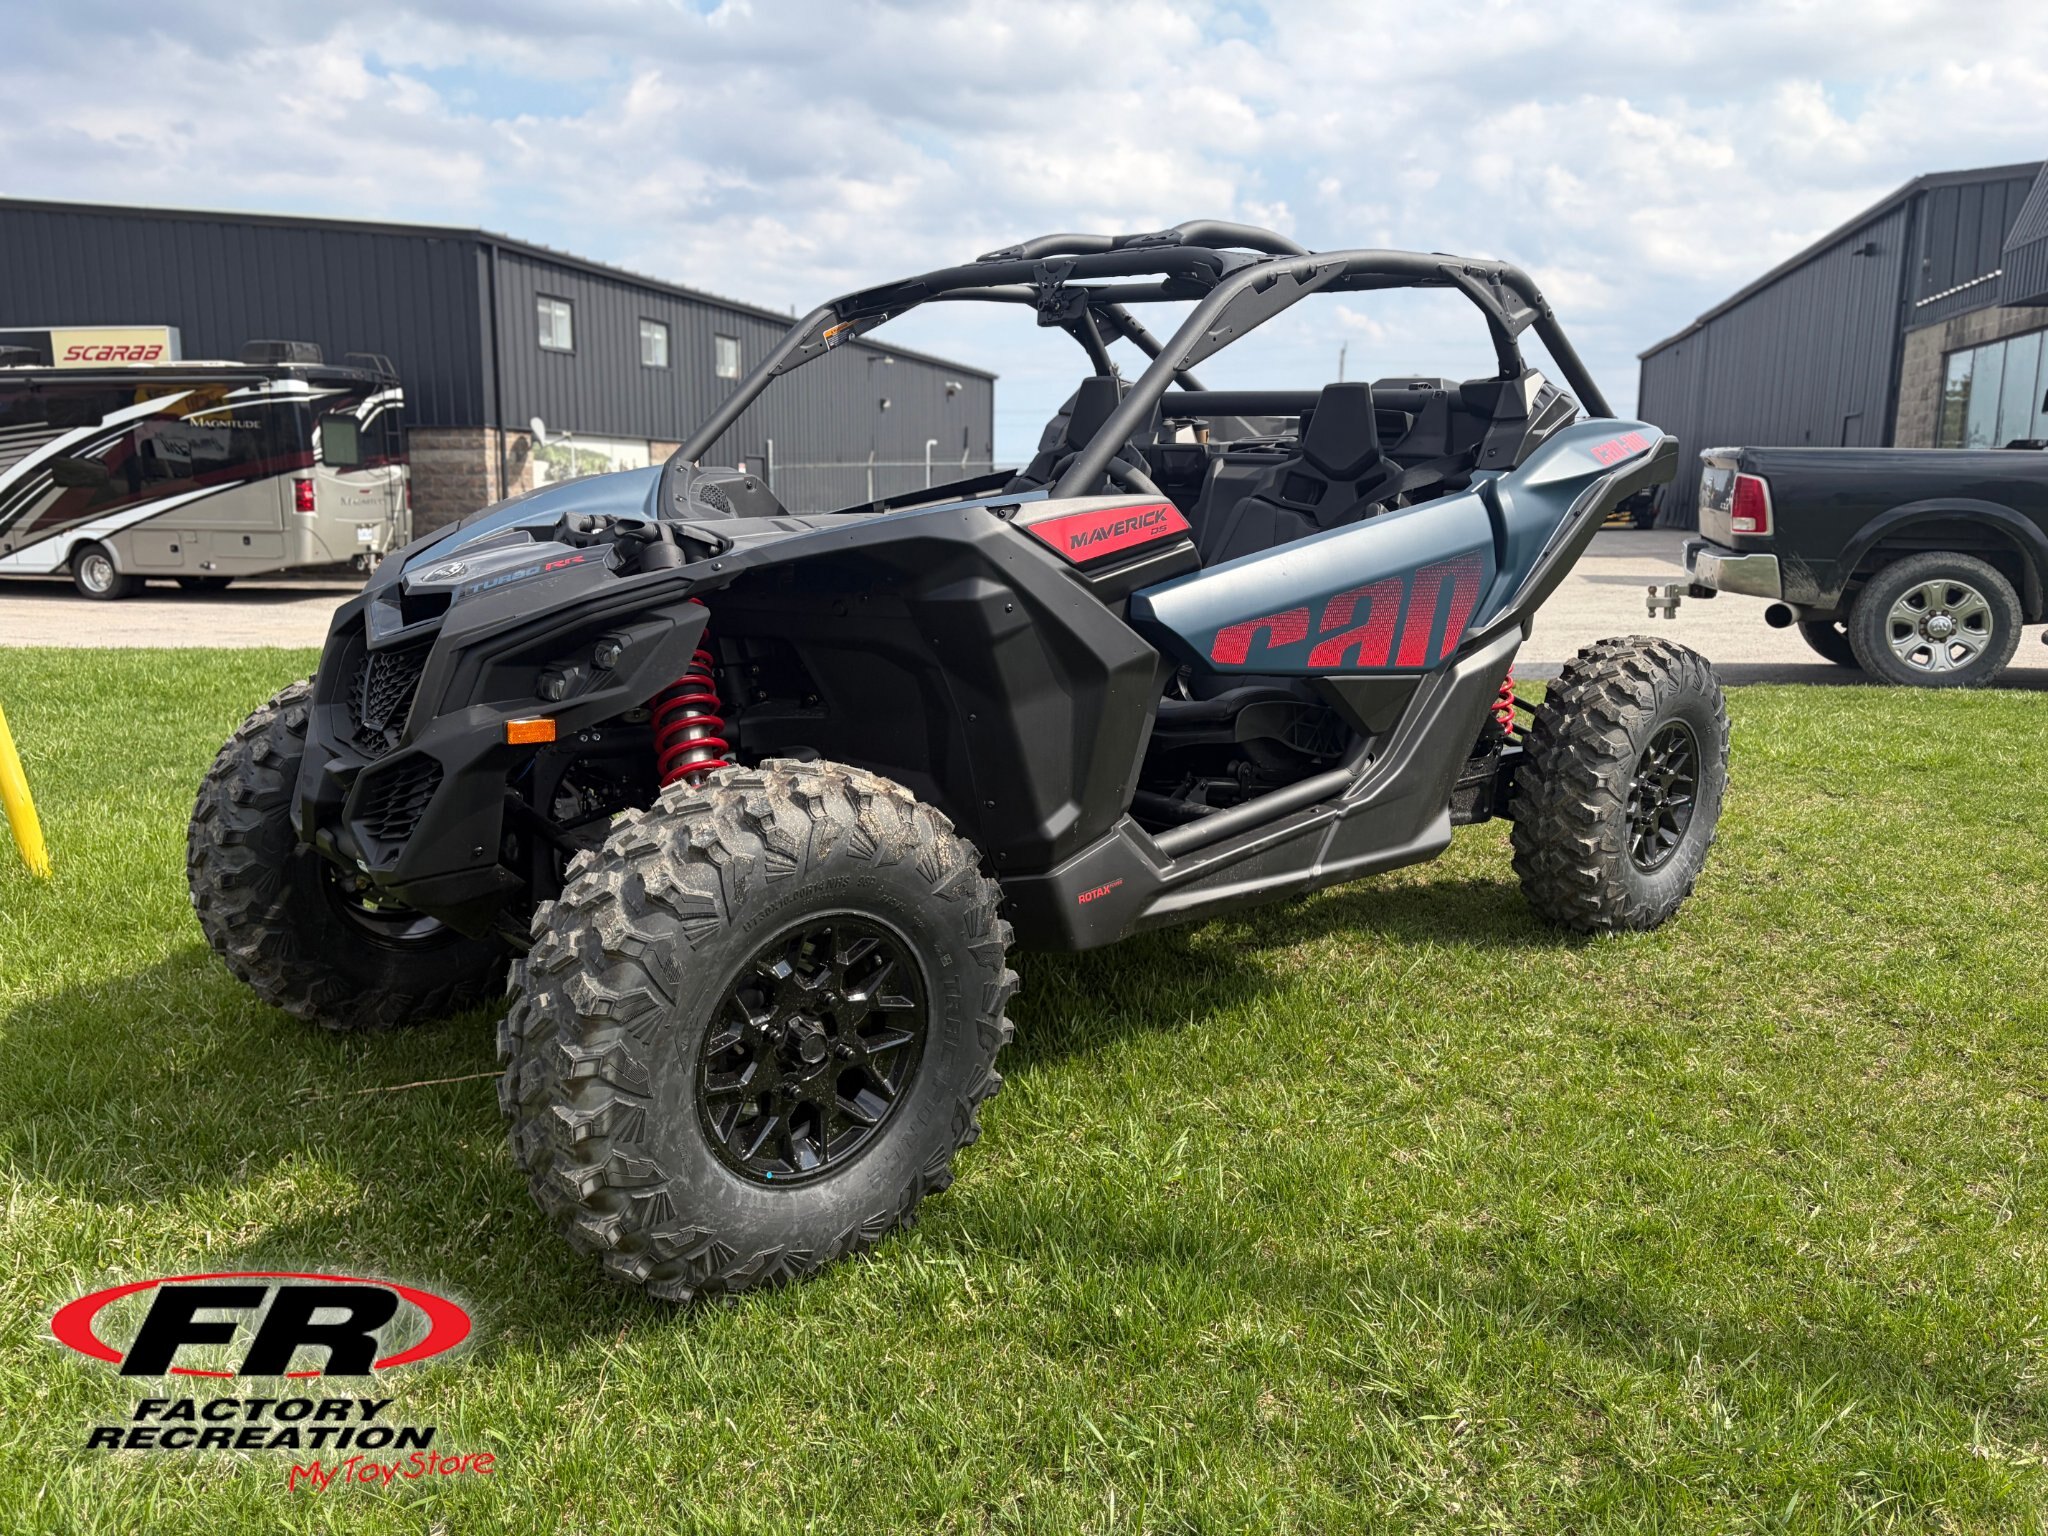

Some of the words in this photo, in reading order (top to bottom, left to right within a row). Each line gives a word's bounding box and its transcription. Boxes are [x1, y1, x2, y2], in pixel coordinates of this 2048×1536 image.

[63, 345, 163, 361] SCARAB
[1070, 507, 1168, 549] MAVERICK
[1150, 524, 1168, 536] DS
[471, 566, 540, 593] TURBO
[545, 554, 585, 571] RR
[1078, 884, 1111, 904] ROTAX
